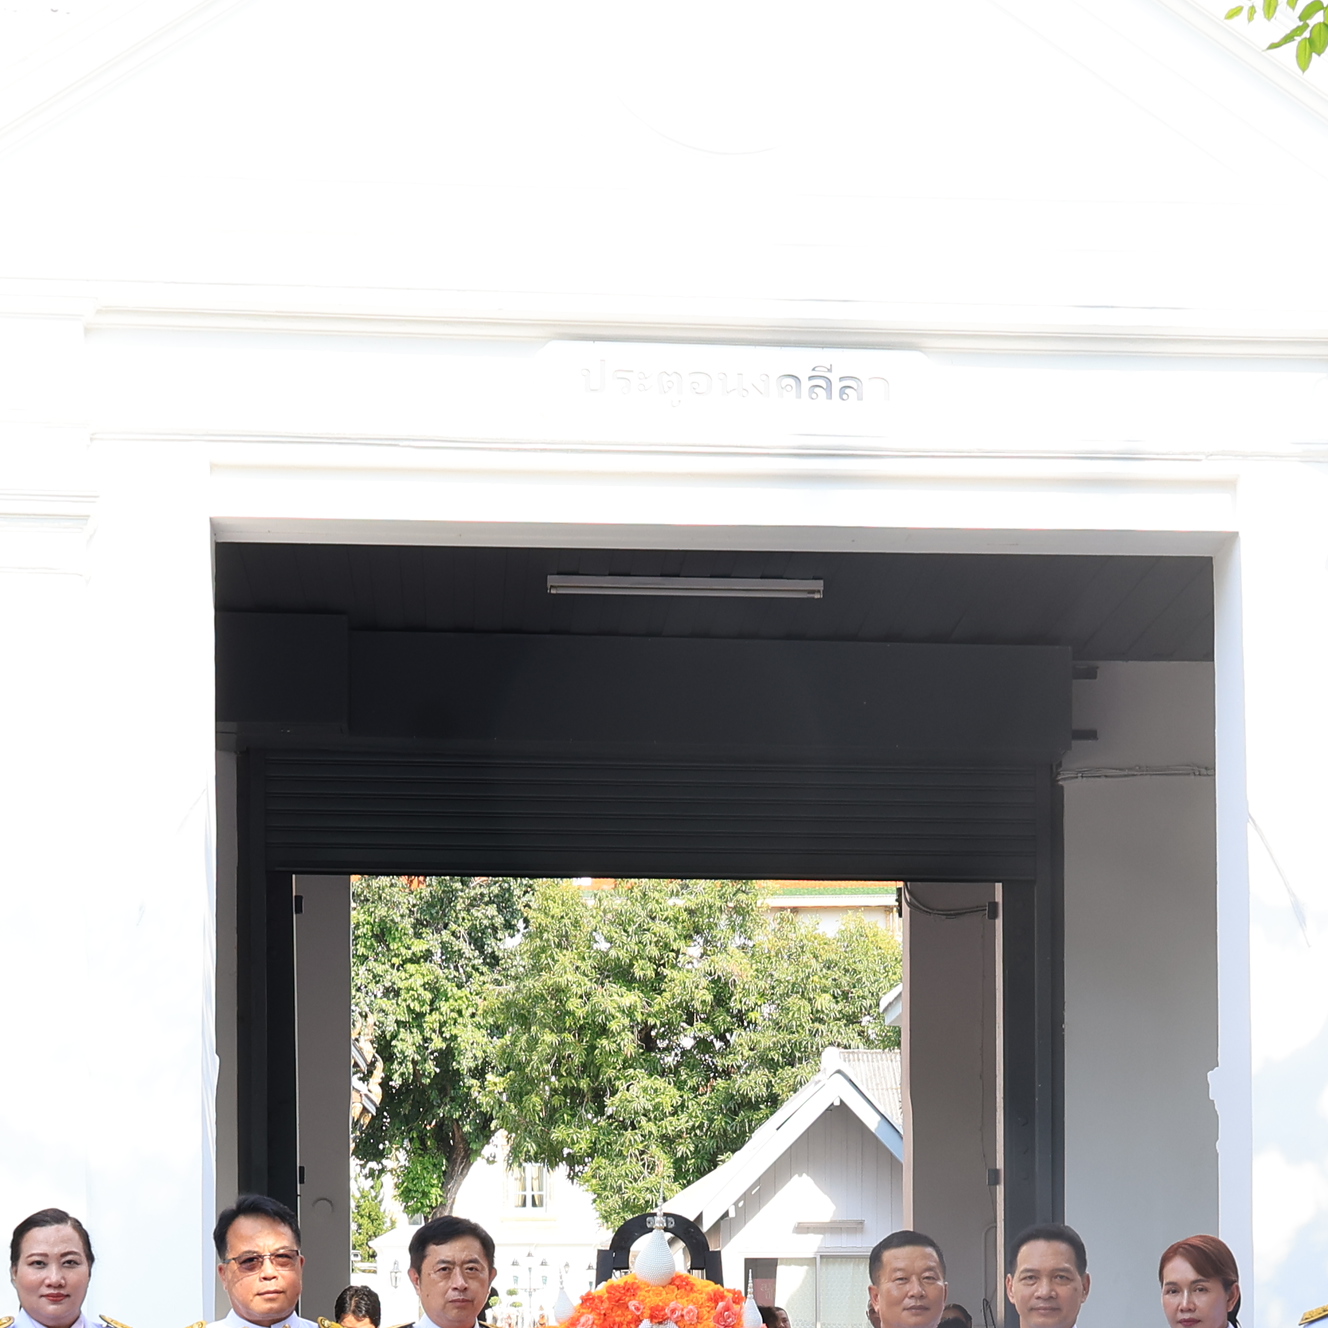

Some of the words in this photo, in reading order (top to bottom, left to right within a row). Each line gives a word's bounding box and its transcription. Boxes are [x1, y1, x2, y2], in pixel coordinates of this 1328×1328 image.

[580, 358, 891, 408] ประตูอนงคลีลา
